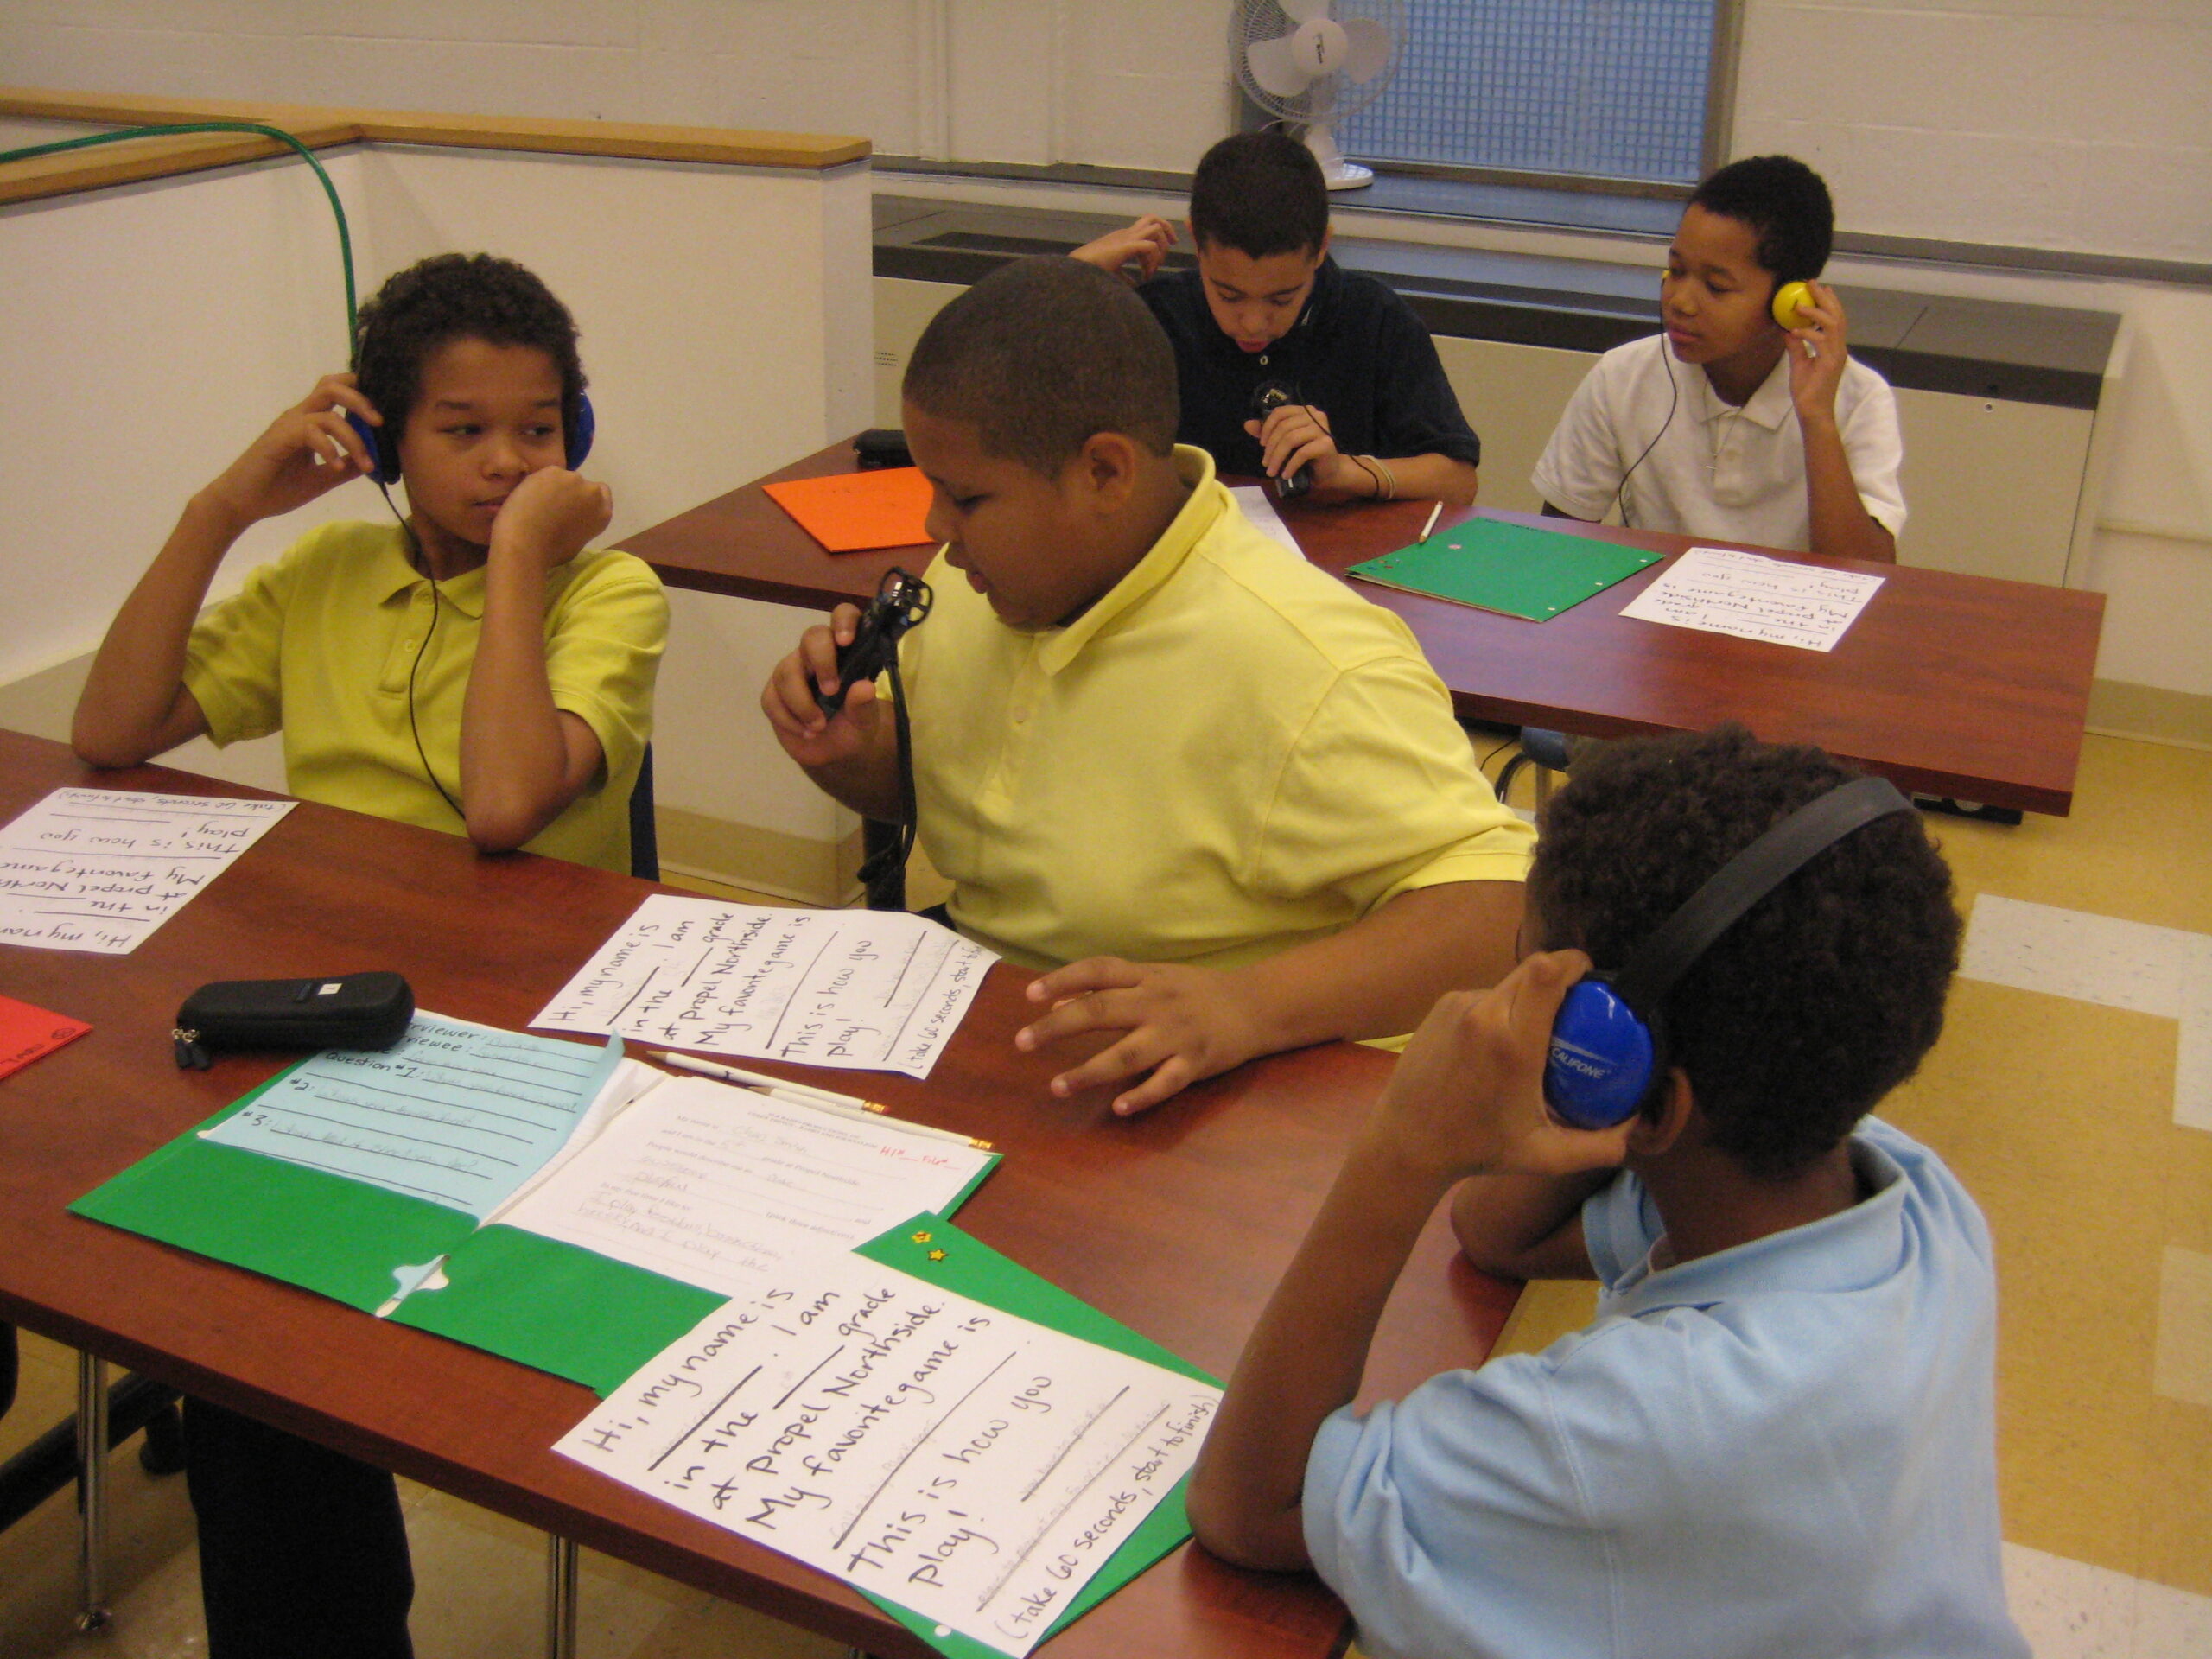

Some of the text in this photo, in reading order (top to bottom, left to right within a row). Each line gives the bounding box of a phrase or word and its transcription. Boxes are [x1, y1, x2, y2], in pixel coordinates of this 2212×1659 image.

[166, 866, 205, 886] My
[89, 899, 133, 913] the
[47, 922, 84, 941] my
[628, 924, 660, 938] is
[671, 919, 695, 942] am
[601, 941, 642, 976] name
[621, 1019, 650, 1033] in
[638, 989, 673, 1014] the
[702, 912, 735, 944] grade
[578, 978, 625, 997] my
[693, 1022, 753, 1046] My
[787, 915, 812, 927] is
[547, 1001, 594, 1021] Hi,
[779, 939, 880, 1058] This is how you
[325, 1051, 391, 1072] Question
[1551, 1046, 1606, 1079] CALIFONE
[799, 1291, 841, 1326] am
[582, 1416, 650, 1452] Hi,
[638, 1373, 703, 1408] my
[681, 1313, 760, 1372] name
[749, 1287, 796, 1311] is
[664, 1465, 706, 1491] in
[700, 1410, 760, 1454] the
[837, 1287, 897, 1345] grade
[745, 1486, 833, 1530] My
[802, 1393, 907, 1477] favorite
[896, 1338, 961, 1405] game
[957, 1316, 992, 1333] is
[846, 1510, 927, 1573] This
[917, 1475, 957, 1500] is
[942, 1419, 1010, 1464] how
[1009, 1376, 1053, 1414] you
[710, 1475, 740, 1510] at
